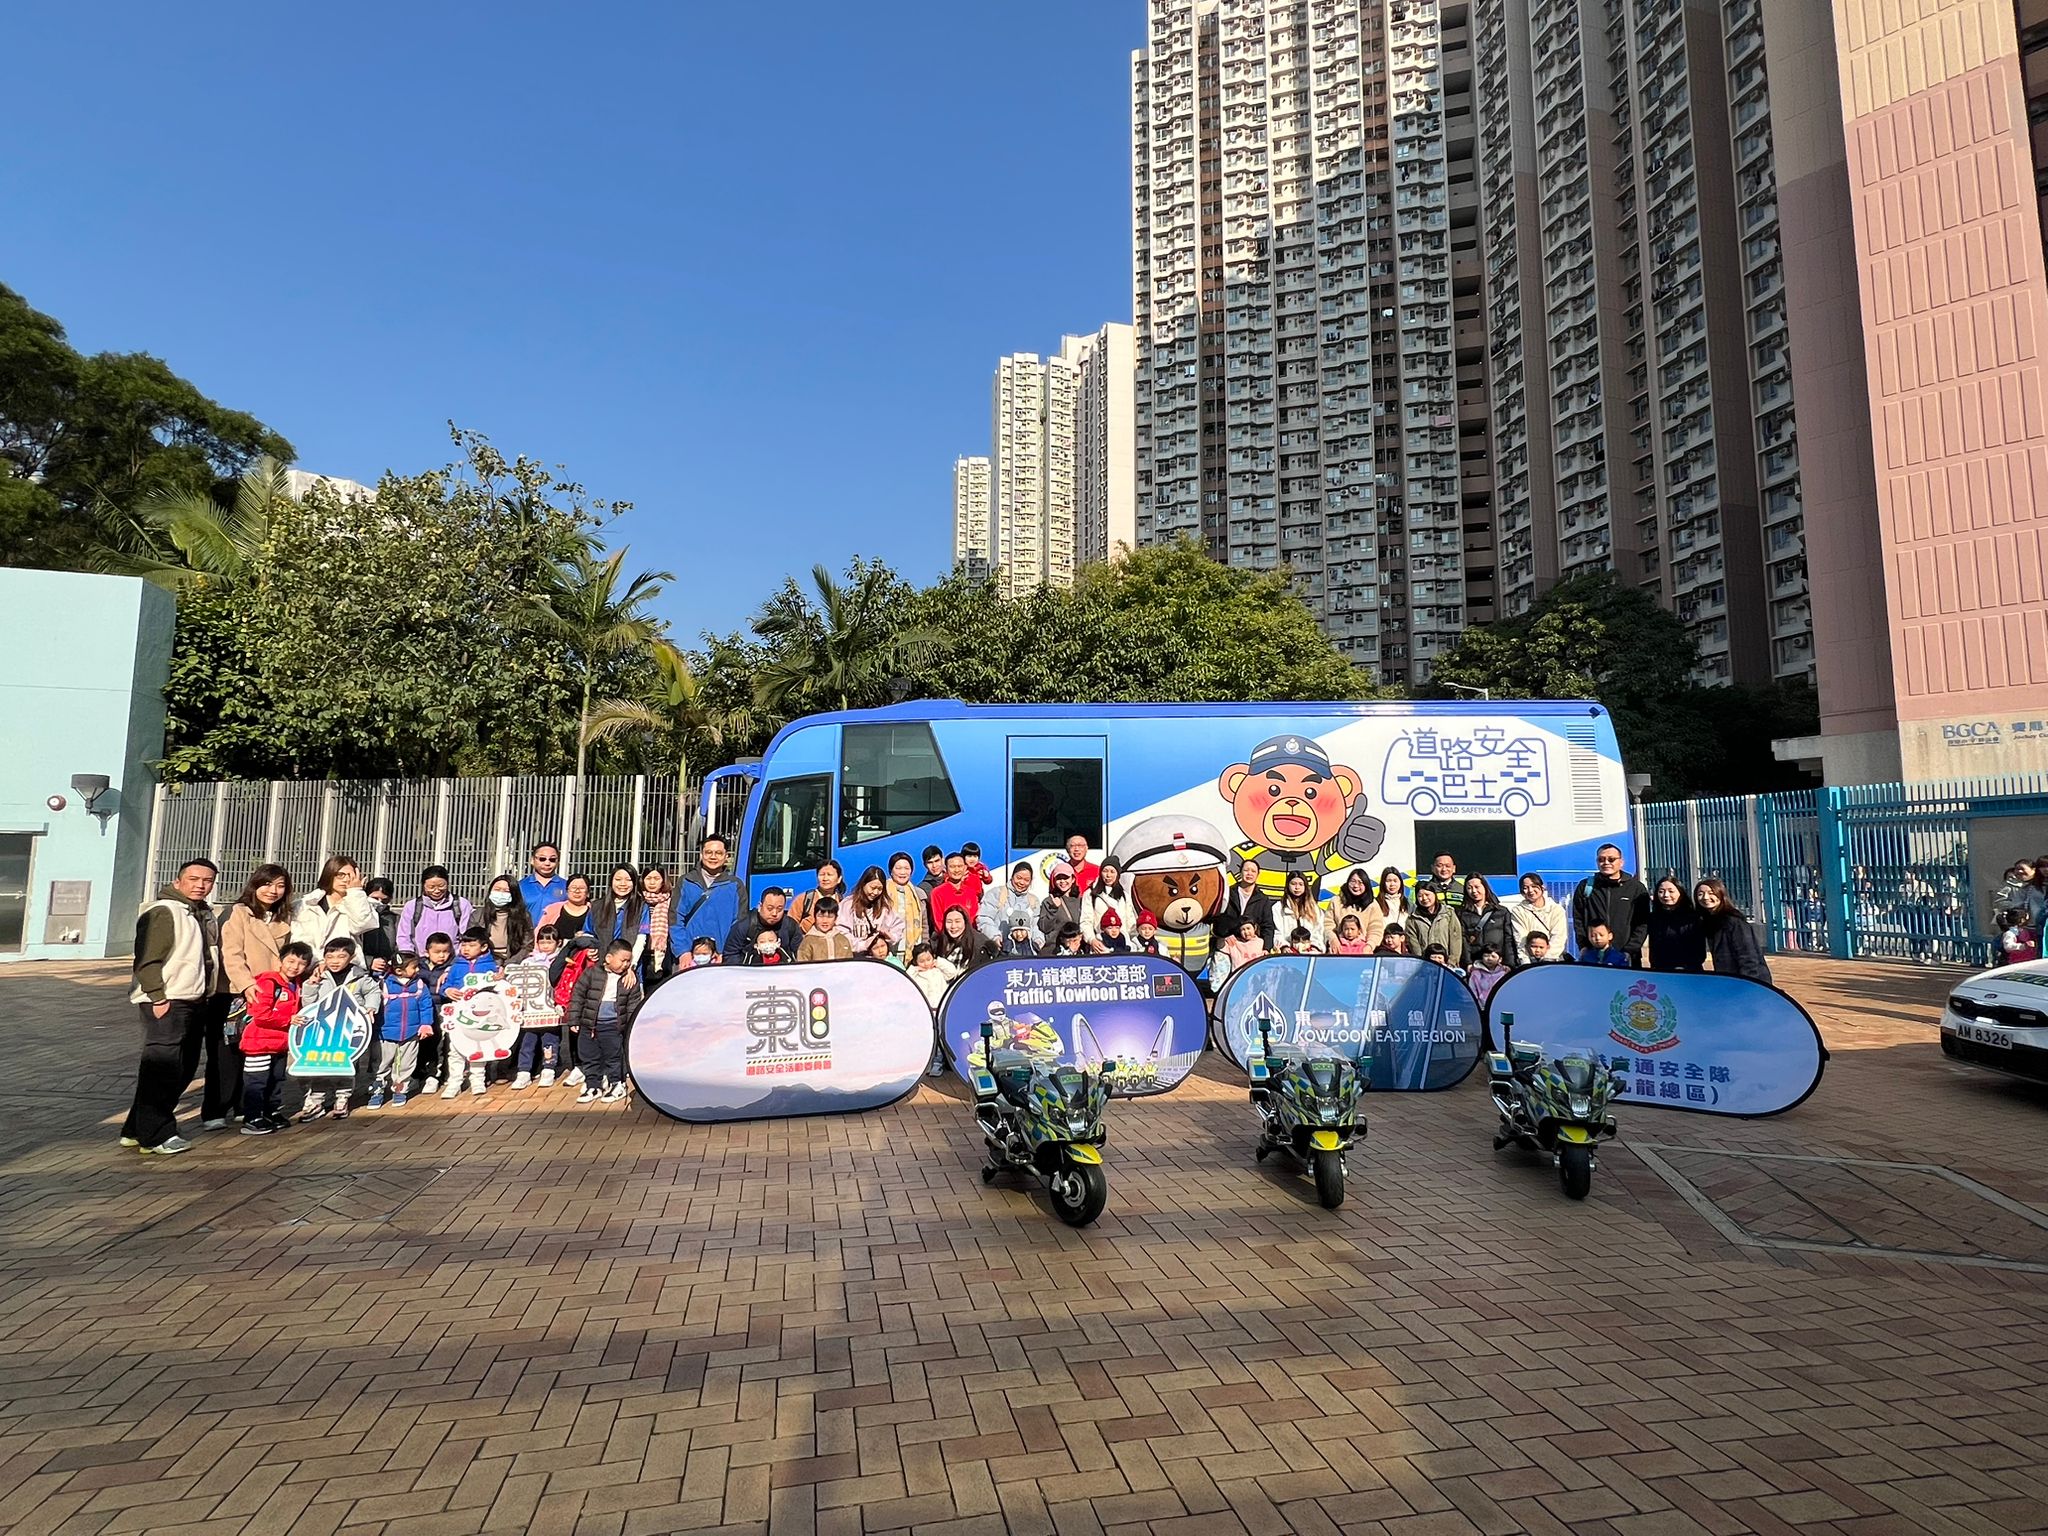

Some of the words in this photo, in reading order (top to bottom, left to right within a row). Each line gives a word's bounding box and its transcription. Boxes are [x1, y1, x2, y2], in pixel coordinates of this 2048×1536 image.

[1942, 721, 2001, 739] BGCA
[1402, 725, 1537, 771] 道路安全
[1442, 773, 1498, 799] 巴士
[1439, 806, 1460, 814] ROAD
[1460, 806, 1486, 814] SAFETY
[1005, 964, 1147, 988] 東九龍總區交通部
[1004, 987, 1053, 1006] Traffic
[1055, 985, 1118, 1003] Kowloon
[1120, 983, 1150, 1000] East
[1298, 1029, 1371, 1043] KOWLOON
[1375, 1029, 1409, 1043] EAST
[1412, 1029, 1466, 1043] REGION
[1957, 1025, 1971, 1039] AM
[1975, 1028, 2009, 1047] 8326
